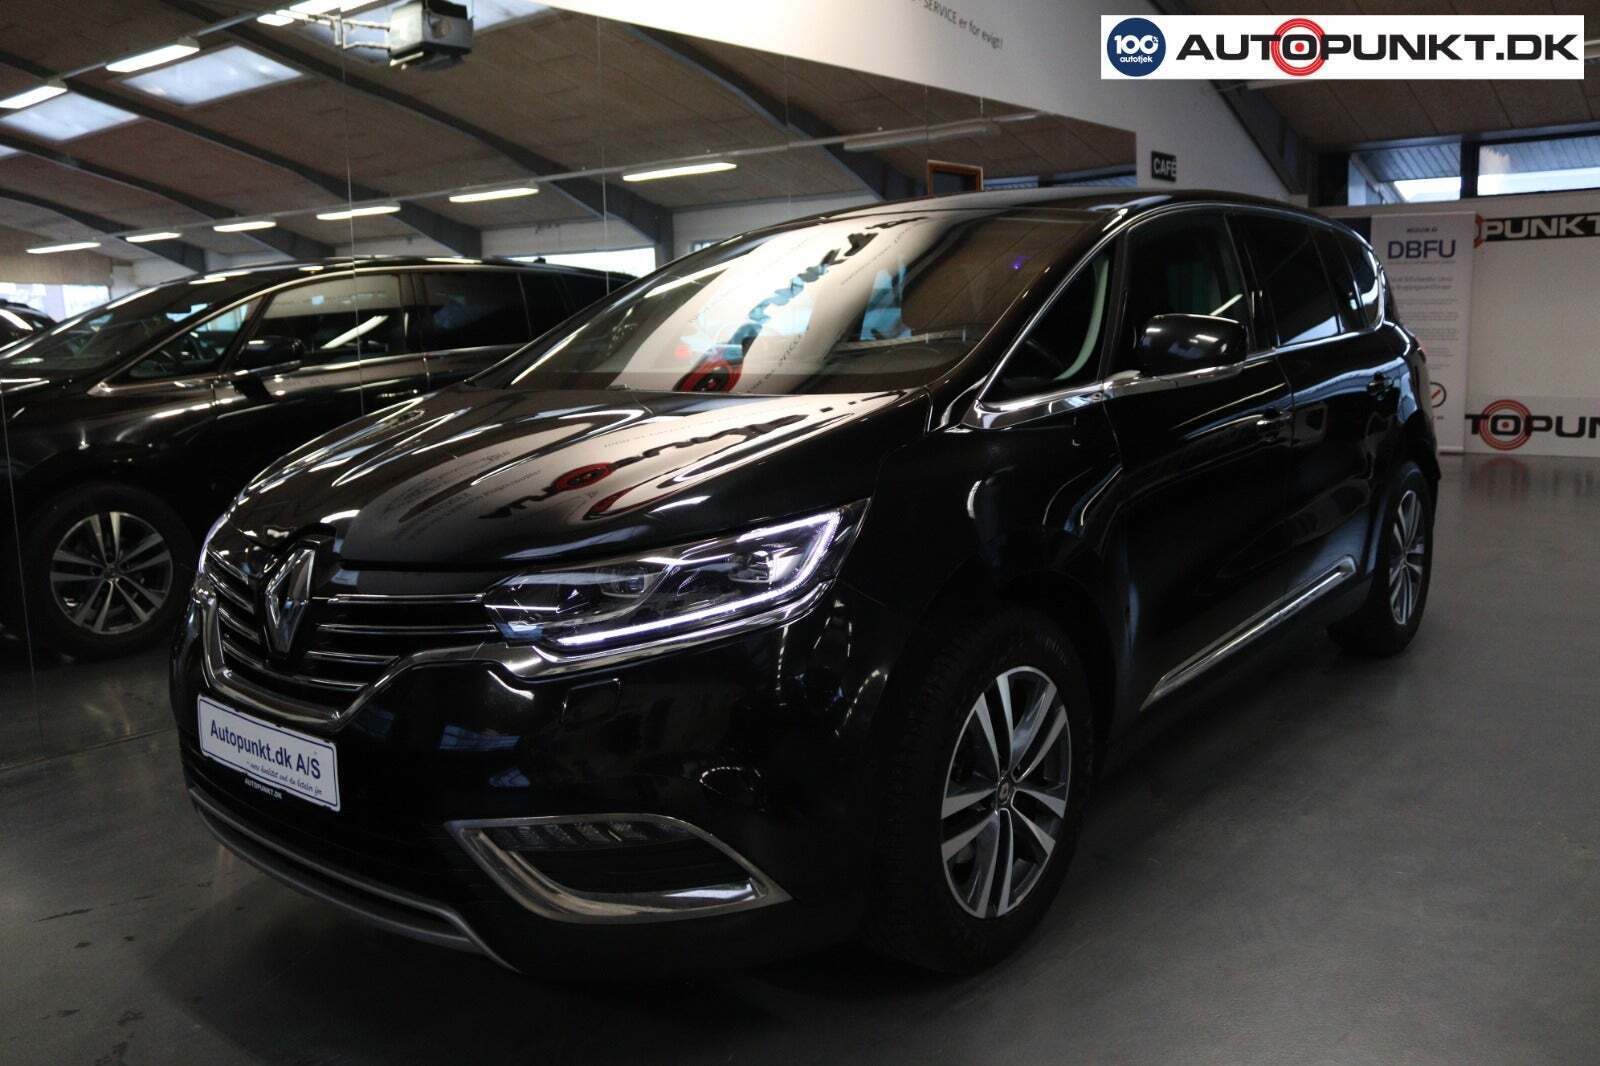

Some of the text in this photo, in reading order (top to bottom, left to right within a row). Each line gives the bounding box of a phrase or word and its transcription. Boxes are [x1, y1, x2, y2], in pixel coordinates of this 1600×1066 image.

[1388, 239, 1456, 259] DBFU
[210, 719, 292, 770] Autopunkt.dk
[296, 753, 321, 779] A/S
